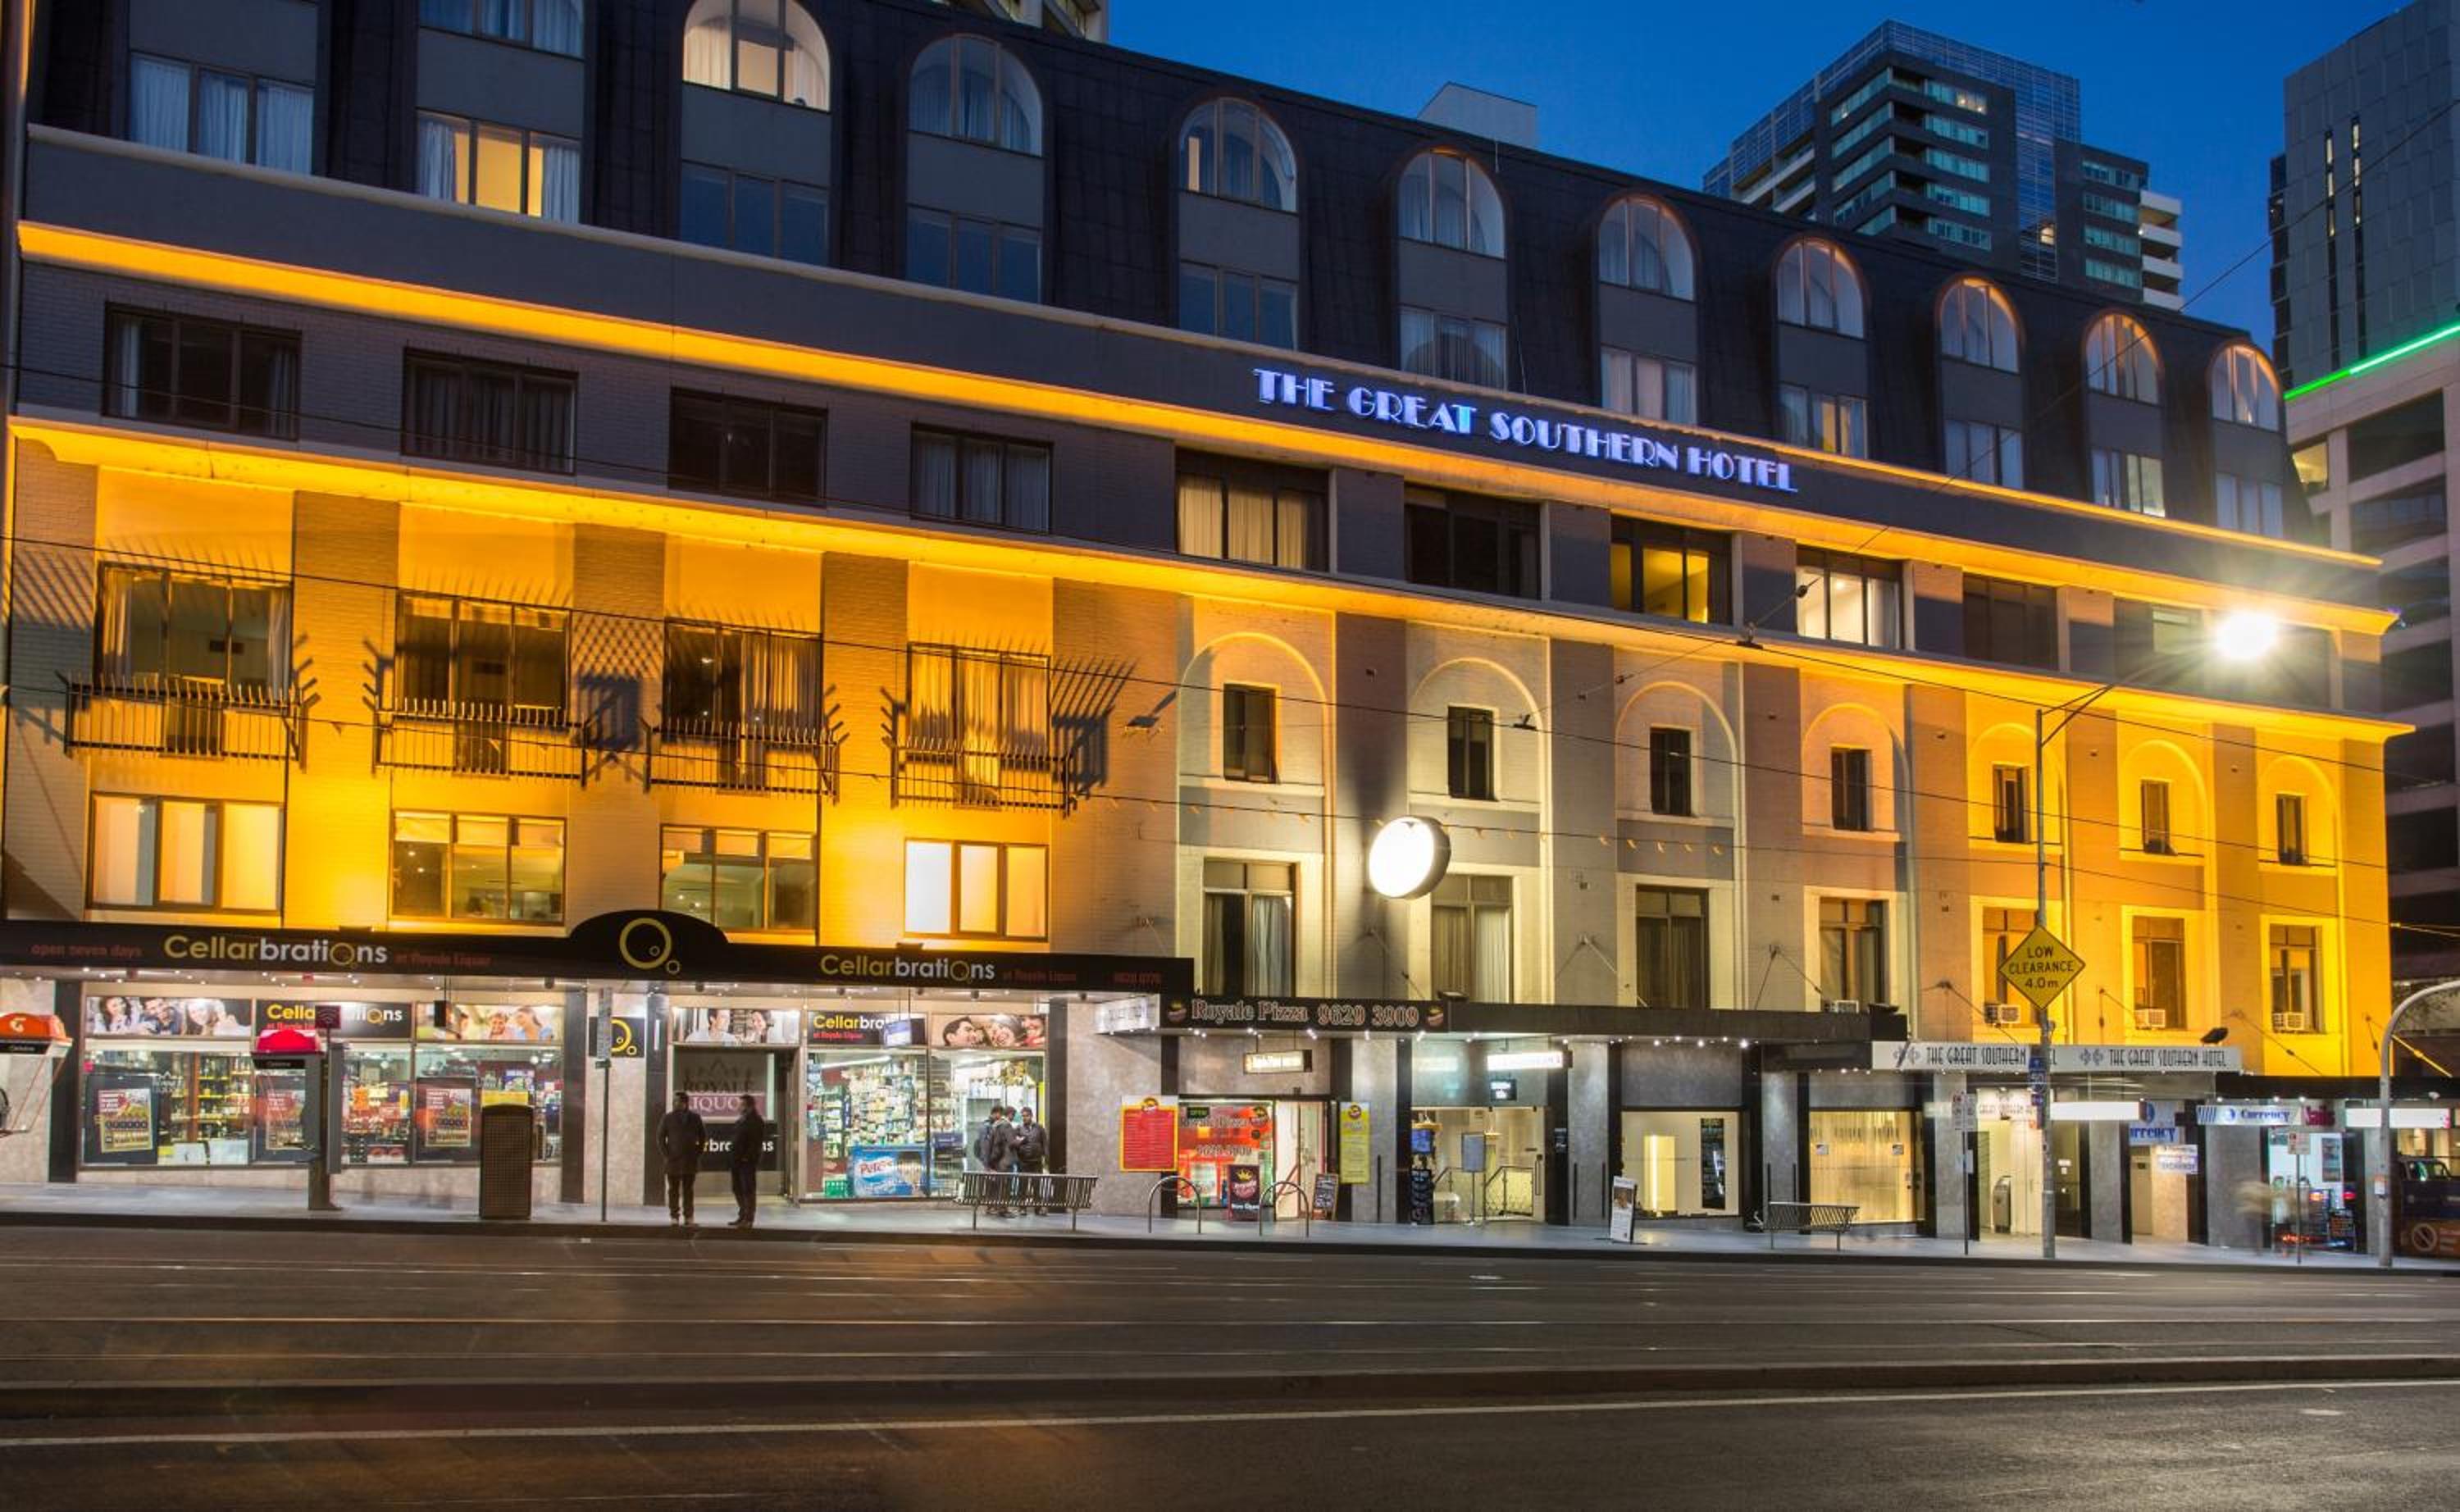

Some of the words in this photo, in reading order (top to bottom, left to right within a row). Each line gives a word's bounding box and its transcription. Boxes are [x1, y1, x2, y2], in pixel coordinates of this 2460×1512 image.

[1254, 368, 1335, 412] THE
[1346, 386, 1477, 435] GREAT
[1488, 411, 1679, 471] SOUTHERN
[1686, 445, 1798, 494] HOTEL
[164, 935, 388, 966] Cellarbrations
[2026, 945, 2054, 959] LOW
[820, 954, 995, 982] Cellarbrations
[2007, 960, 2074, 974] CLEARANCE
[1191, 998, 1255, 1024] Royale
[1258, 1001, 1310, 1022] Pizza
[1926, 1046, 1943, 1065] THE
[1947, 1047, 1977, 1065] GREAT
[1982, 1047, 2025, 1066] SOUTHERN
[2109, 1049, 2124, 1067] THE
[2128, 1050, 2154, 1067] GREAT
[2158, 1050, 2198, 1068] SOUTHERN
[2203, 1050, 2227, 1068] HOTEL
[689, 1095, 741, 1112] IQUO
[2240, 1109, 2290, 1123] Currency
